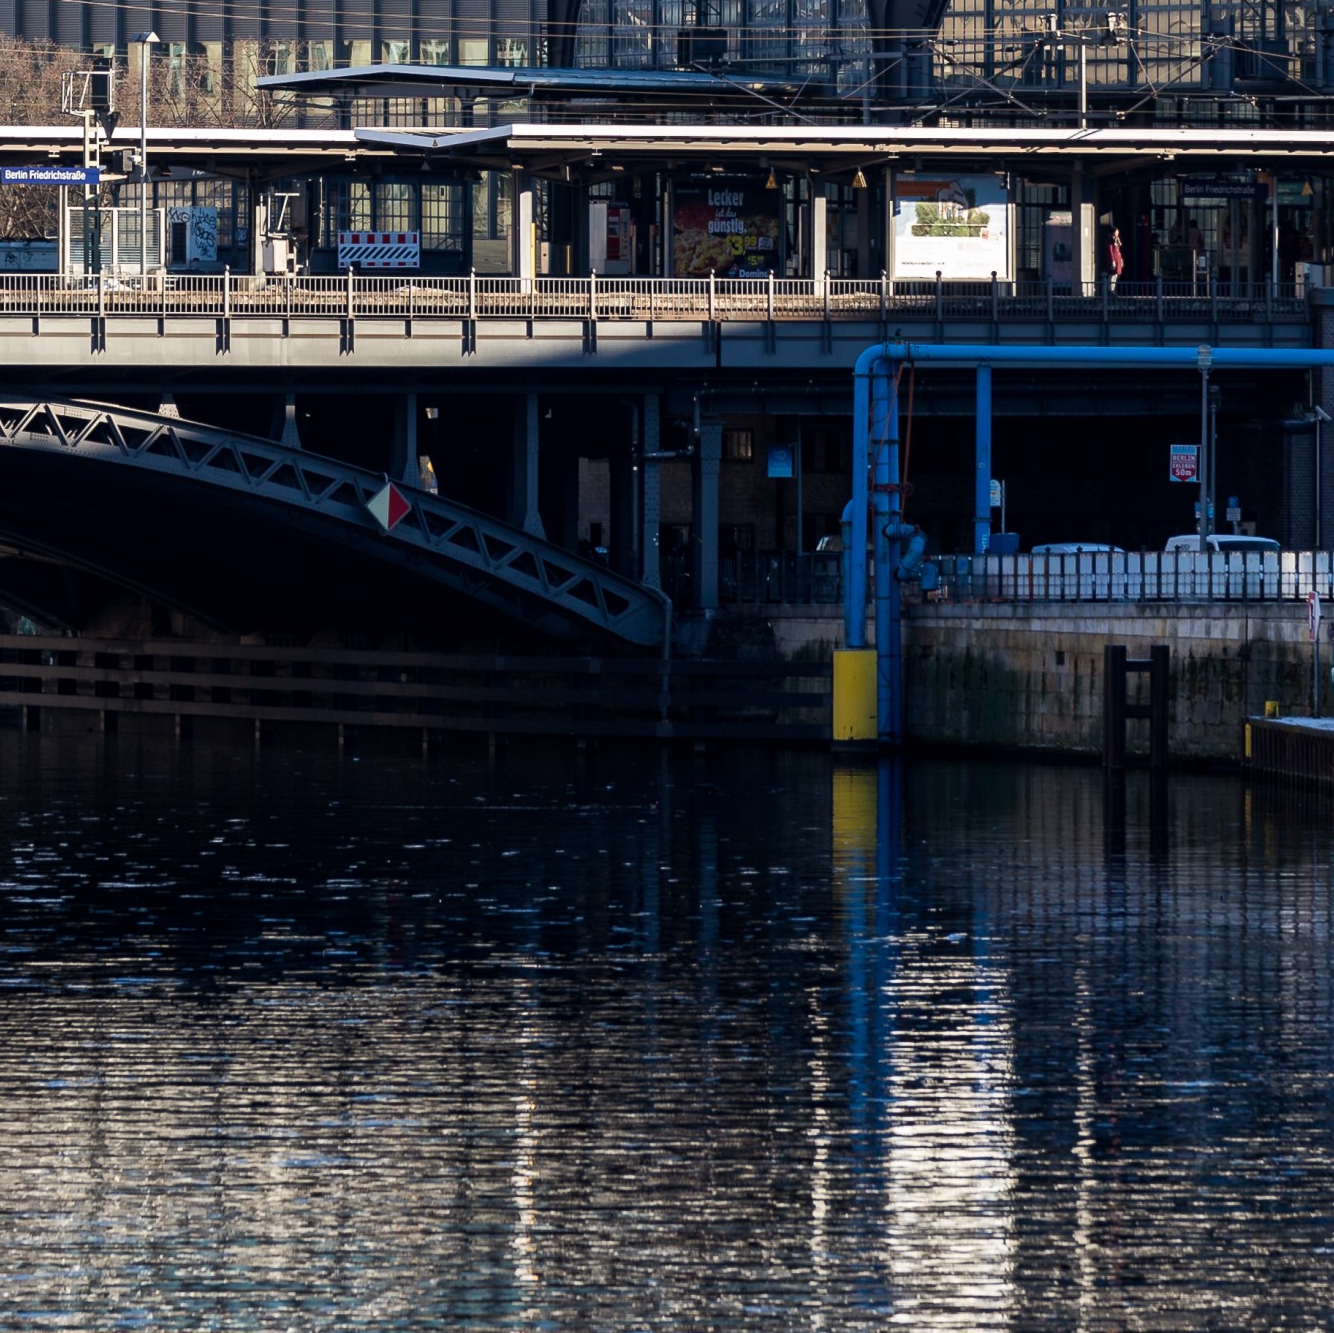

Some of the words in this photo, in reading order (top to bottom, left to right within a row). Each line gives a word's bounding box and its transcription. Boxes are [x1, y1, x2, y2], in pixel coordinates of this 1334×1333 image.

[4, 169, 28, 180] Berlin
[29, 169, 86, 181] Friedrichstraße
[1184, 185, 1204, 194] Berlin
[1205, 185, 1256, 195] Friedrichstraße
[708, 188, 744, 207] Lecker
[708, 218, 748, 234] günstig.
